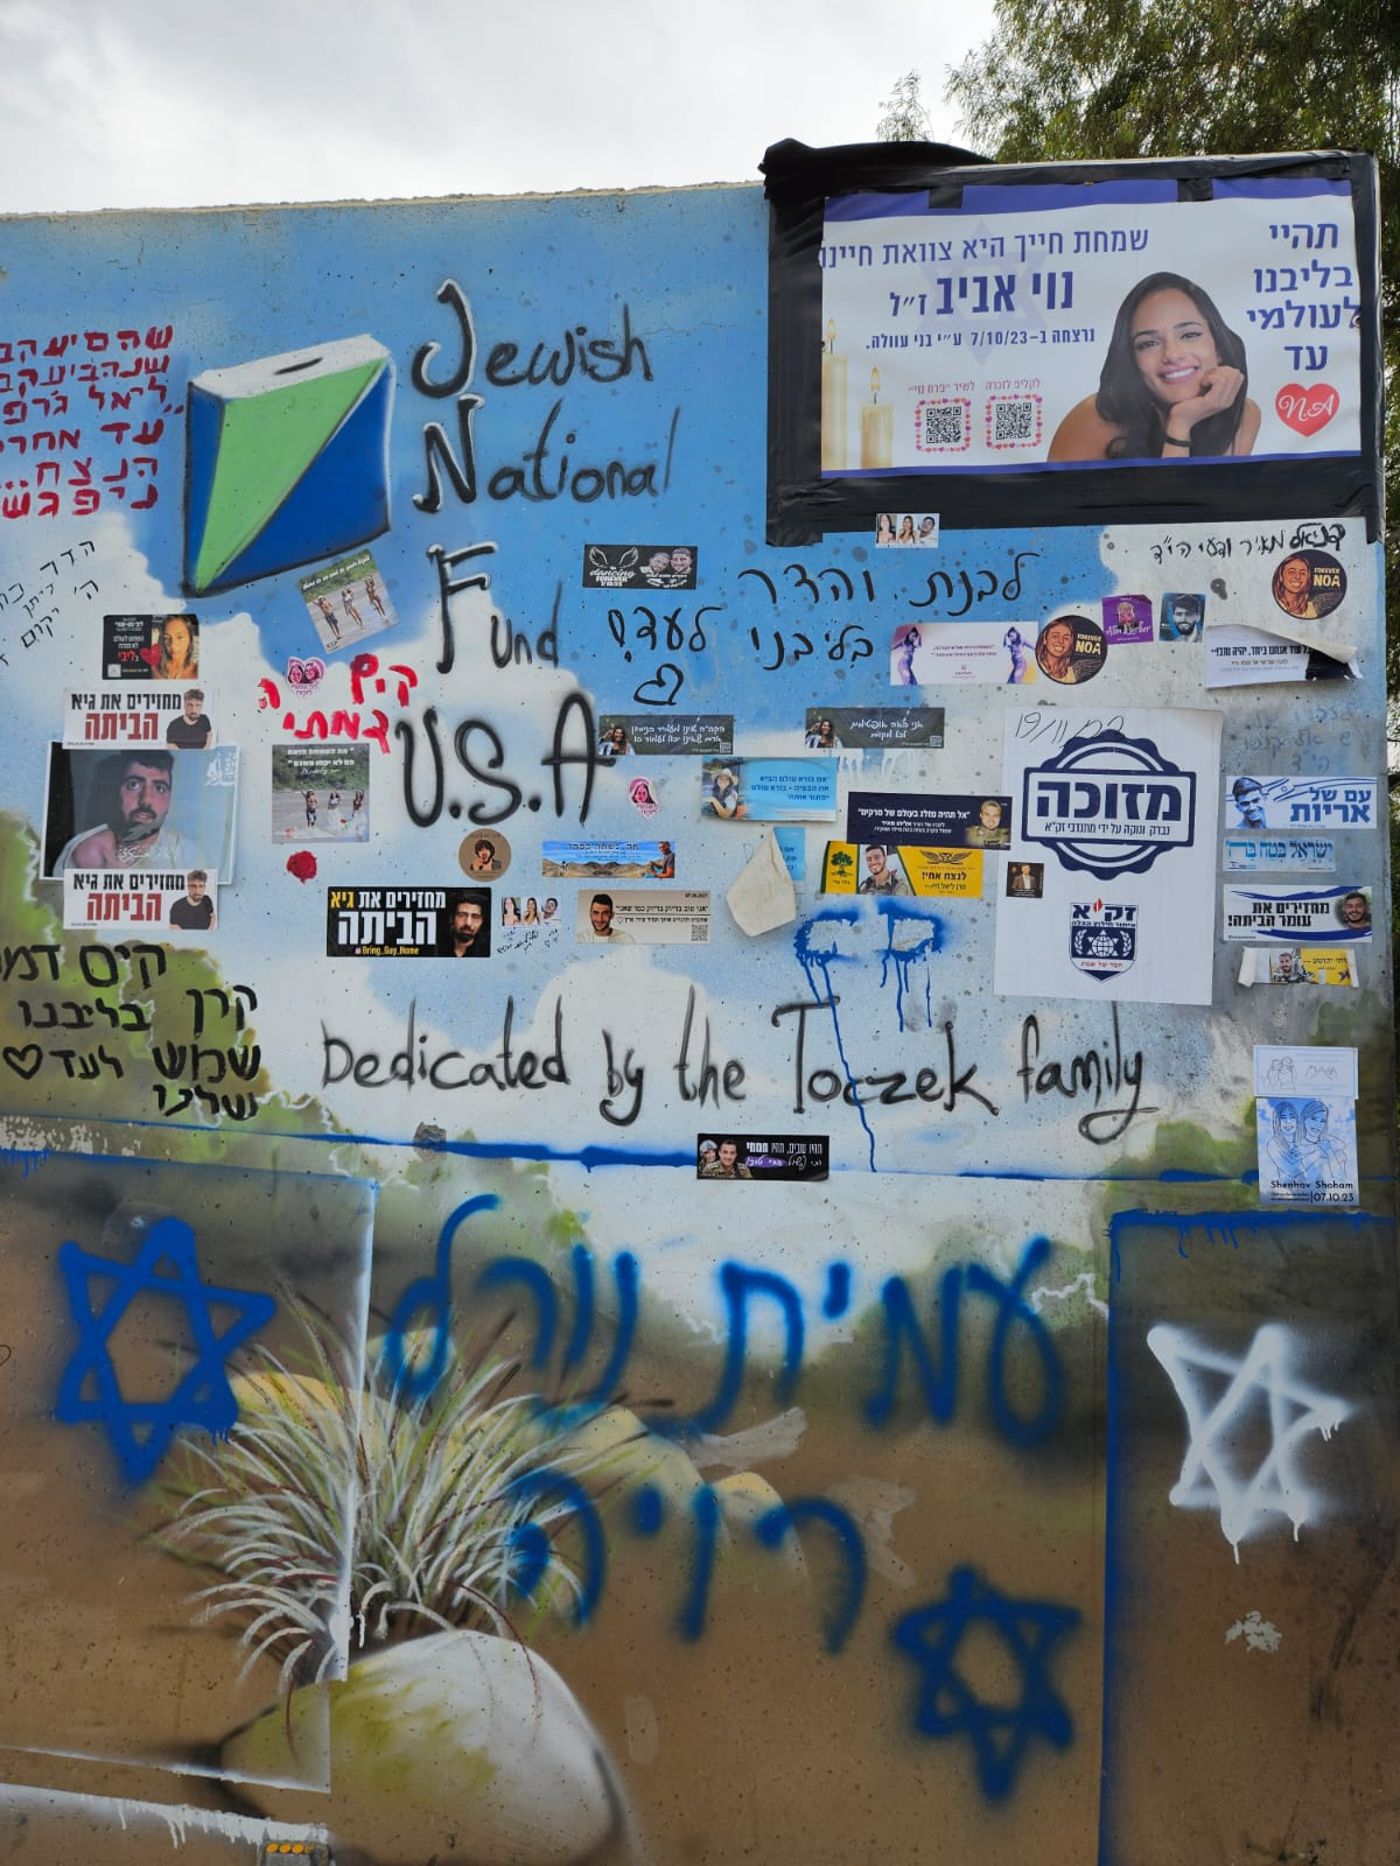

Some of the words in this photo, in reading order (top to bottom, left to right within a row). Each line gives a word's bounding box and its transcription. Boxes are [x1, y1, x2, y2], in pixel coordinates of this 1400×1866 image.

[1073, 229, 1148, 253] שמחת
[1269, 222, 1339, 250] תהיי
[882, 241, 952, 265] צוואת
[962, 236, 1005, 260] היא
[1014, 233, 1064, 263] חייך
[1253, 259, 1353, 293] בליבנו
[936, 274, 1016, 315] אביב
[1032, 271, 1074, 310] נוי
[411, 278, 654, 398] Jewish
[914, 335, 932, 348] בני
[1051, 328, 1095, 345] נרצחה
[1284, 345, 1328, 371] עד
[412, 393, 681, 514] National
[40, 540, 95, 575] הדר
[1313, 574, 1341, 588] NOA
[426, 540, 563, 675] Fund
[1075, 641, 1102, 655] NOA
[71, 693, 96, 710] גיא
[100, 693, 121, 710] את
[127, 693, 181, 710] מחזירים
[84, 712, 158, 740] הביתה
[1036, 781, 1183, 821] מזוכה
[1308, 787, 1338, 802] של
[1345, 789, 1371, 803] עם
[883, 808, 895, 817] של
[1290, 803, 1370, 823] אריות
[1098, 823, 1109, 831] ידי
[1111, 823, 1121, 834] על
[73, 873, 98, 890] גיא
[103, 873, 124, 891] את
[129, 873, 185, 891] מחזירים
[944, 871, 967, 880] לנצח
[87, 893, 162, 921] הביתה
[330, 891, 355, 908] גיא
[358, 891, 381, 909] את
[386, 891, 446, 909] מחזירים
[1252, 903, 1272, 913] את
[1276, 903, 1329, 913] מחזירים
[338, 911, 437, 945] הביתה
[1279, 915, 1312, 927] עומר
[320, 995, 571, 1091] Dedicated
[600, 1028, 644, 1127] by
[673, 984, 746, 1109] the
[770, 995, 999, 1116] Toczek
[1016, 1000, 1160, 1144] family
[1270, 1180, 1310, 1189] Shenhav
[1315, 1180, 1353, 1189] Shoham
